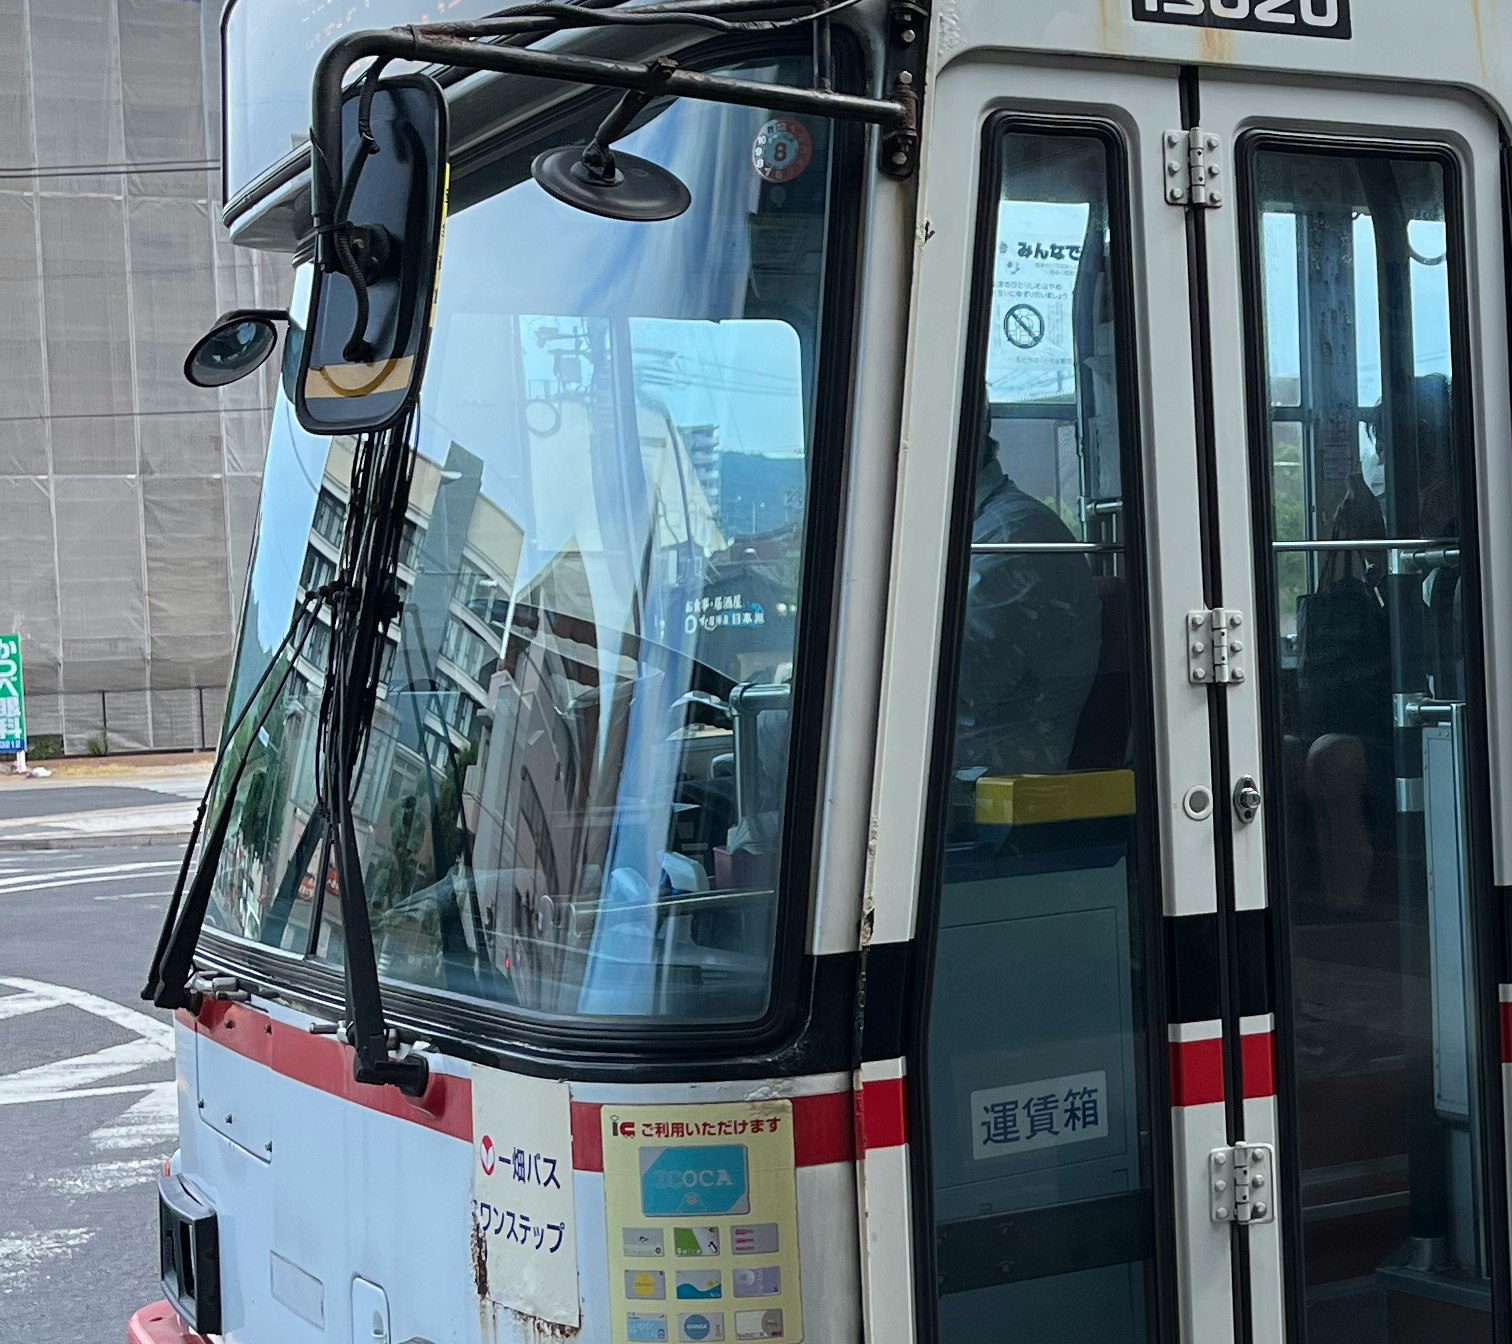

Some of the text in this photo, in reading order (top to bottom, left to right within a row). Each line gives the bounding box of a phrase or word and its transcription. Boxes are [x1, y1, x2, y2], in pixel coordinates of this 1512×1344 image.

[641, 1117, 781, 1137] ご利用いただけます
[980, 1086, 1099, 1145] 運賃箱
[498, 1147, 561, 1189] 一畑バス
[480, 1202, 565, 1253] ワンステップ
